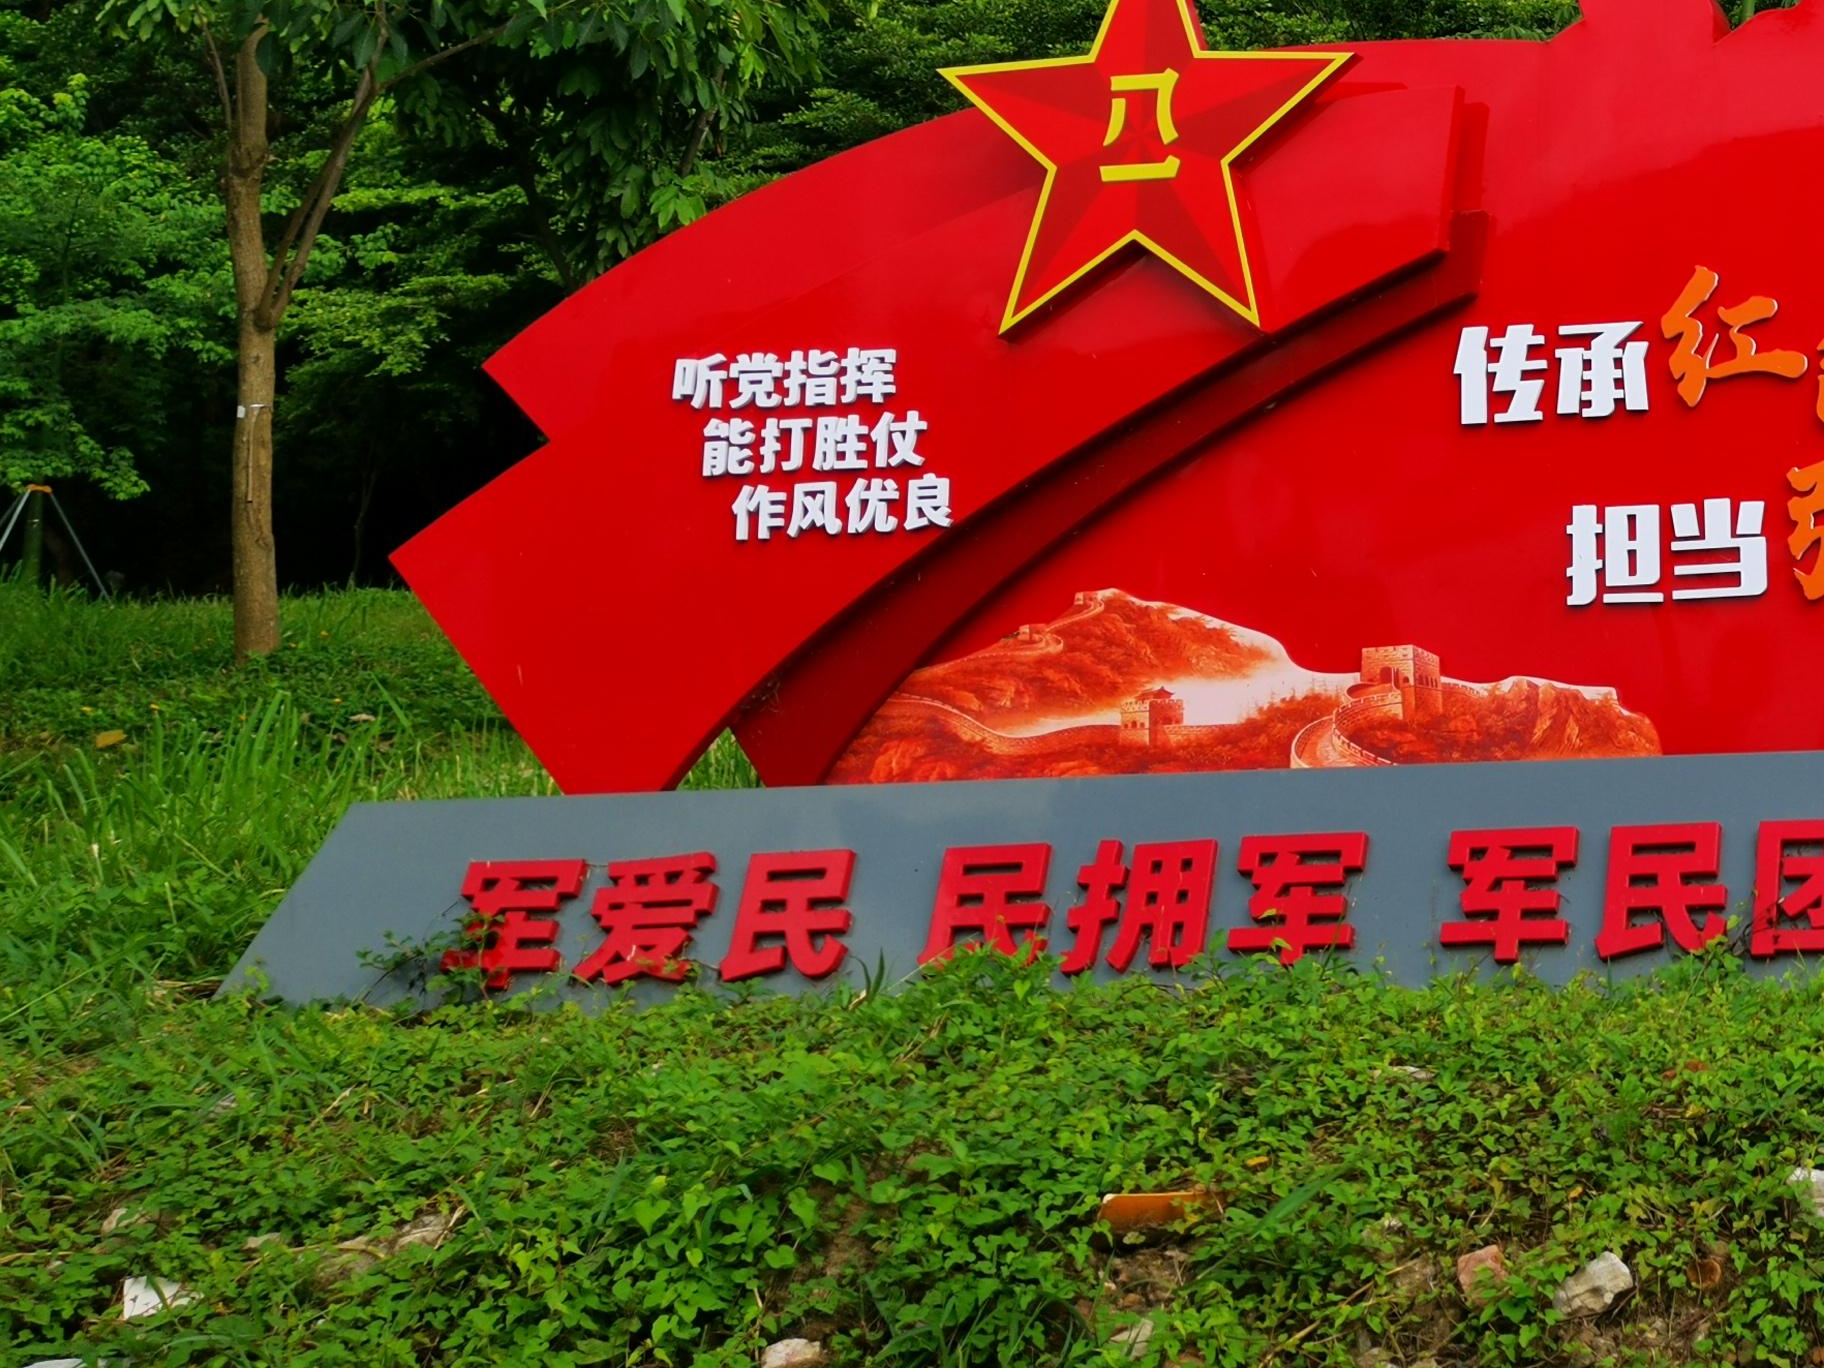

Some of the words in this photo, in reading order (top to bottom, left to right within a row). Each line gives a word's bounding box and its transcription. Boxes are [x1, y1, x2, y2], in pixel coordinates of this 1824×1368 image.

[1100, 68, 1181, 182] 八一
[671, 347, 896, 409] 听党指挥
[702, 410, 927, 477] 能打胜仗
[731, 472, 953, 541] 作风优良
[441, 849, 857, 990] 军爱民
[917, 832, 1369, 976] 民拥军
